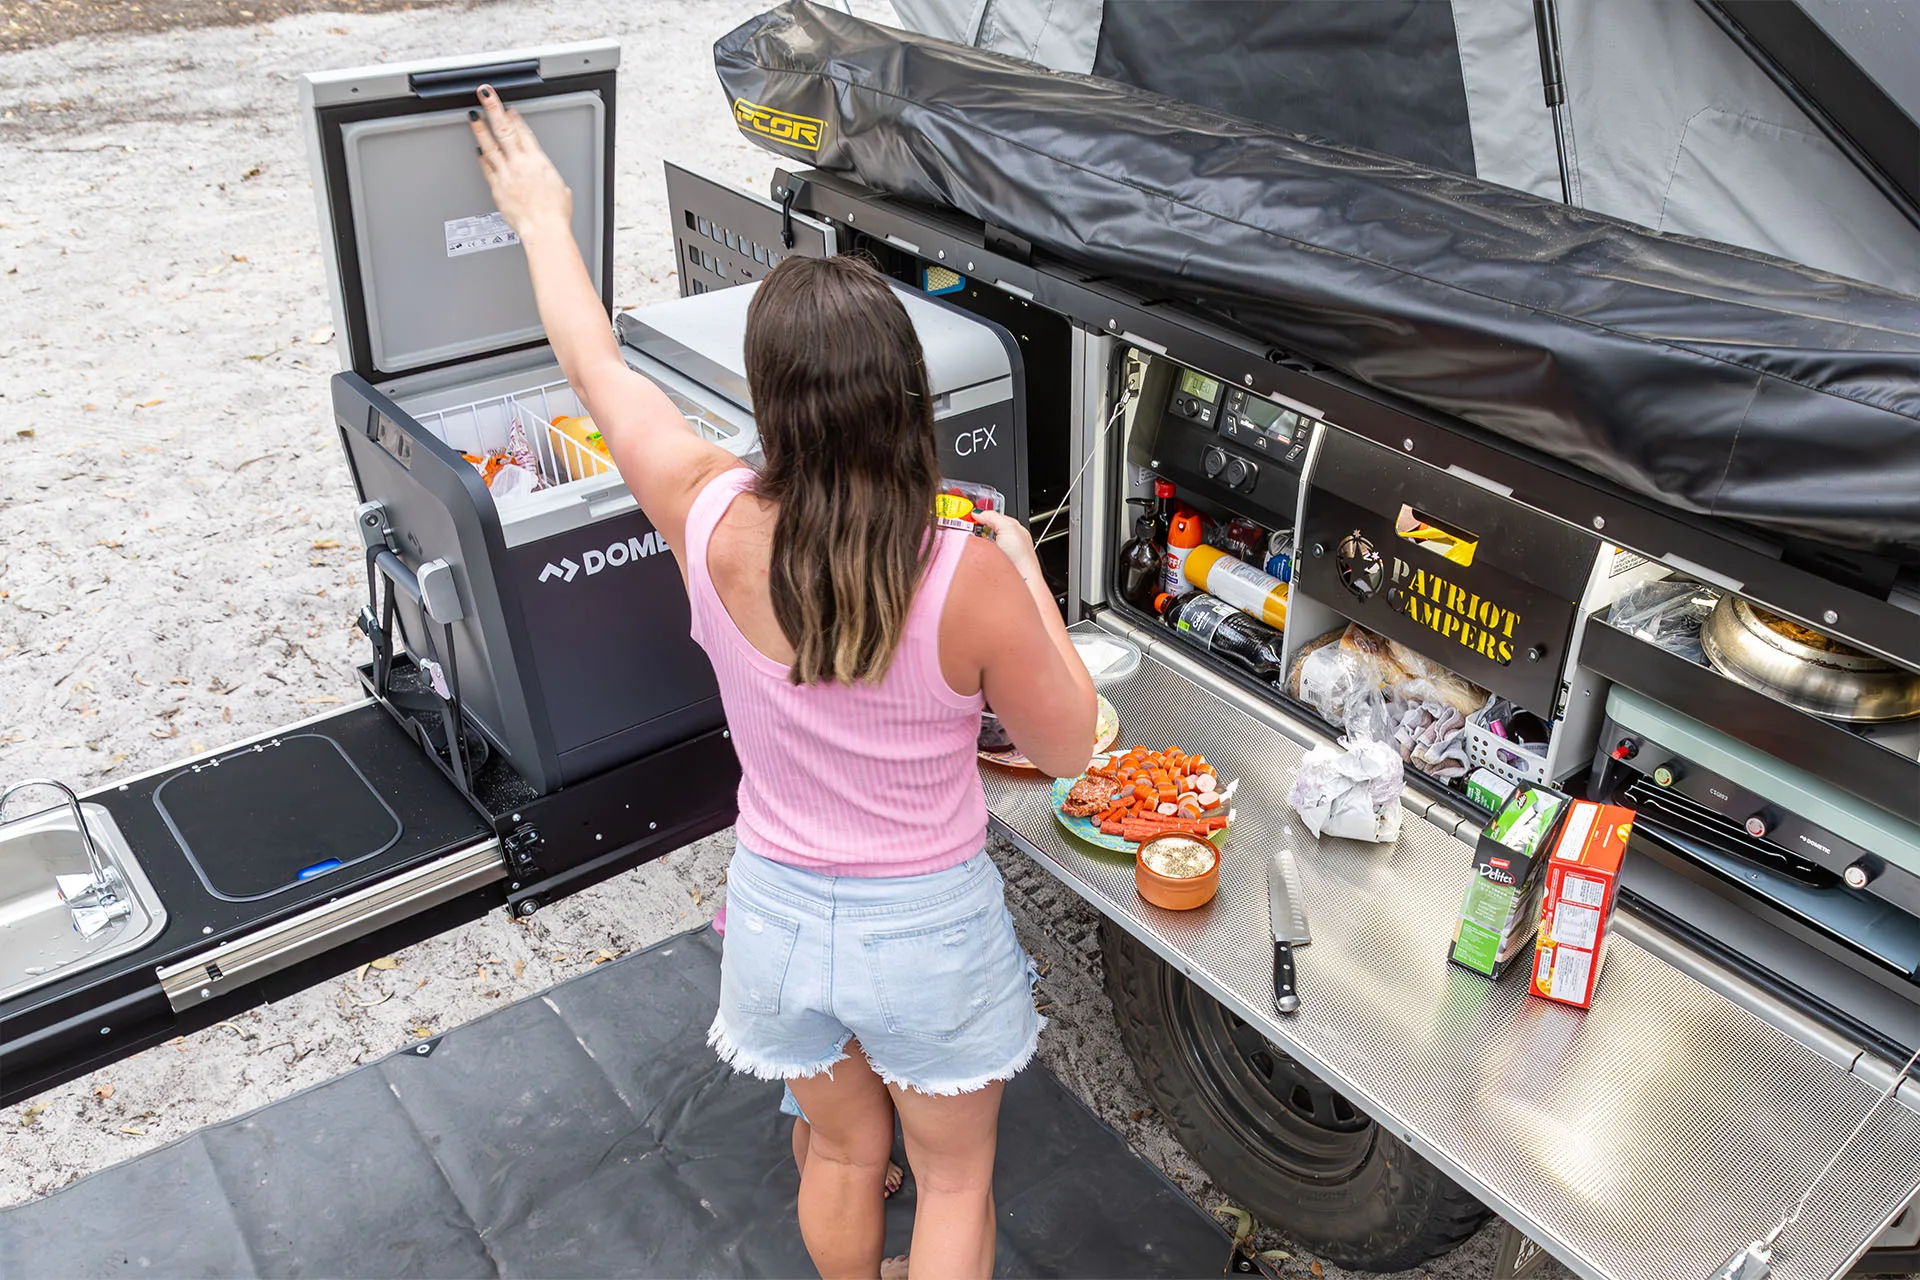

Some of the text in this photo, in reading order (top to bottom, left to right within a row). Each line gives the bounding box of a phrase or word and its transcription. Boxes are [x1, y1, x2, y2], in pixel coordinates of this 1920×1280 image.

[955, 423, 997, 456] CFX
[582, 530, 671, 576] DOME
[1391, 556, 1521, 639] PATRIOT
[1386, 586, 1515, 667] CAMPERS
[1806, 838, 1832, 855] DOMETIC
[1479, 862, 1513, 884] Delites
